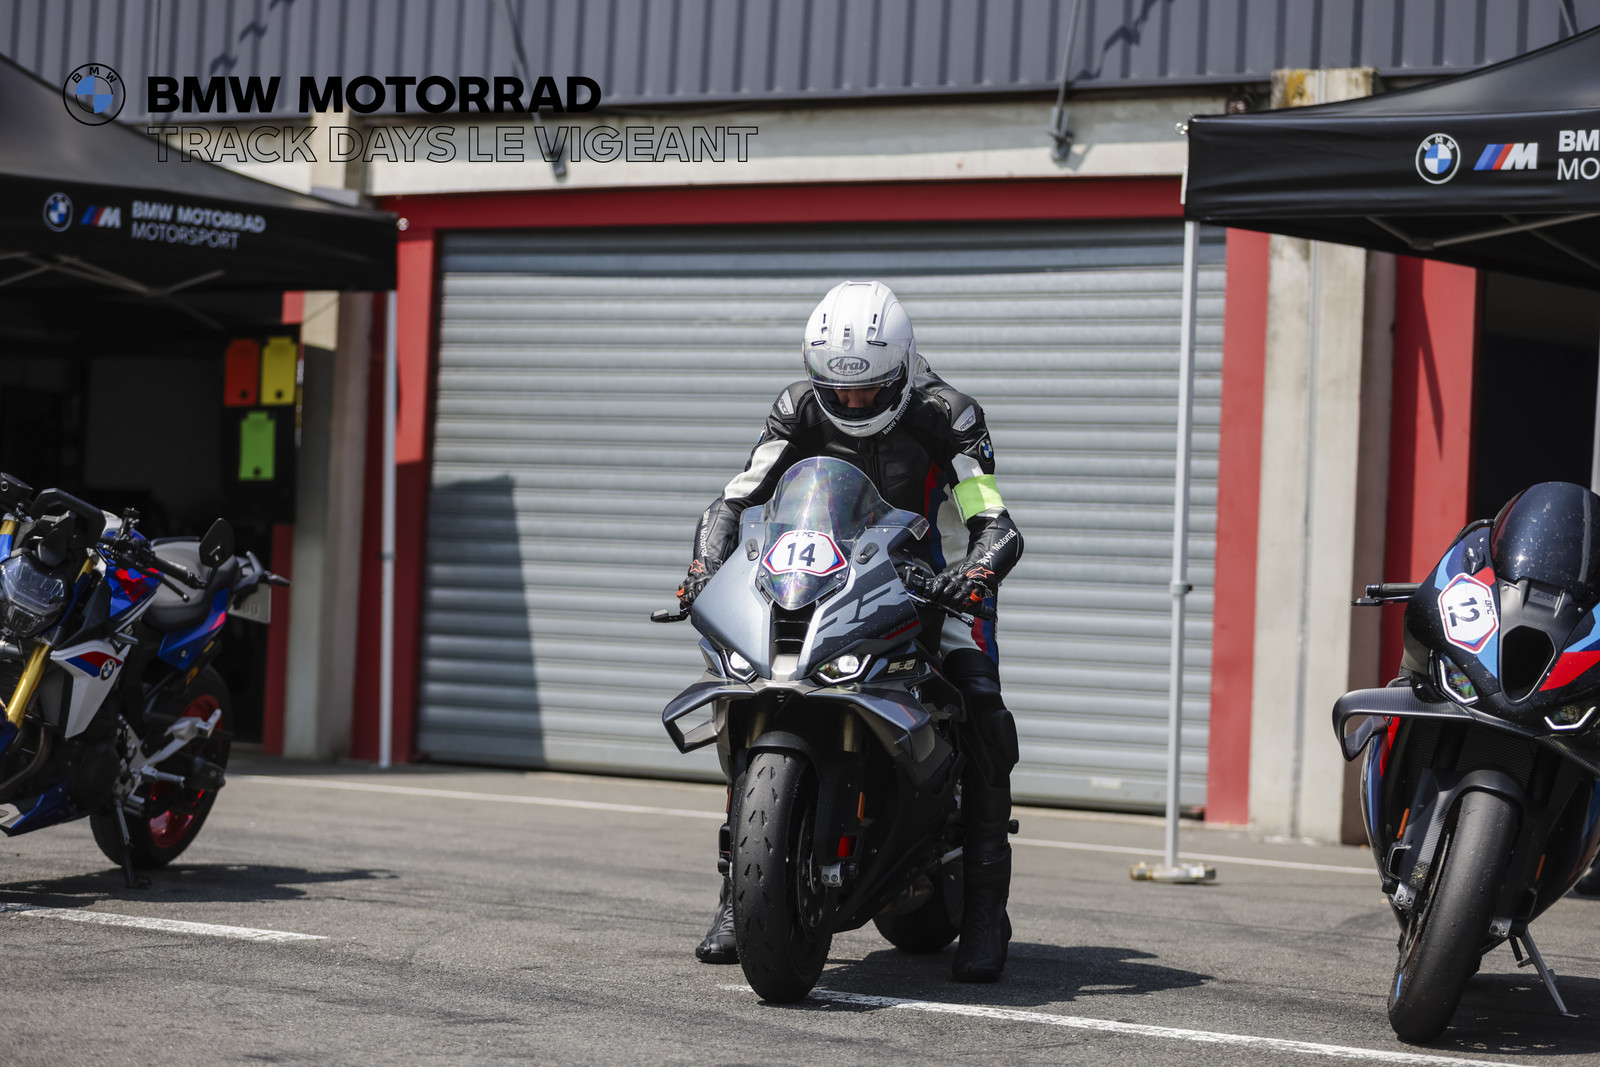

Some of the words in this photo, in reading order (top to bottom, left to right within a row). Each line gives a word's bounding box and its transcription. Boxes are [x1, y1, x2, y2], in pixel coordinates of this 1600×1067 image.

[131, 200, 174, 222] BMW
[176, 206, 266, 234] MOTORRAD
[131, 220, 240, 249] MOTORSPORT
[832, 358, 866, 371] Arai
[882, 420, 897, 435] BMW
[991, 528, 1017, 551] Motorrad
[787, 542, 816, 567] 14
[1447, 596, 1481, 628] 12
